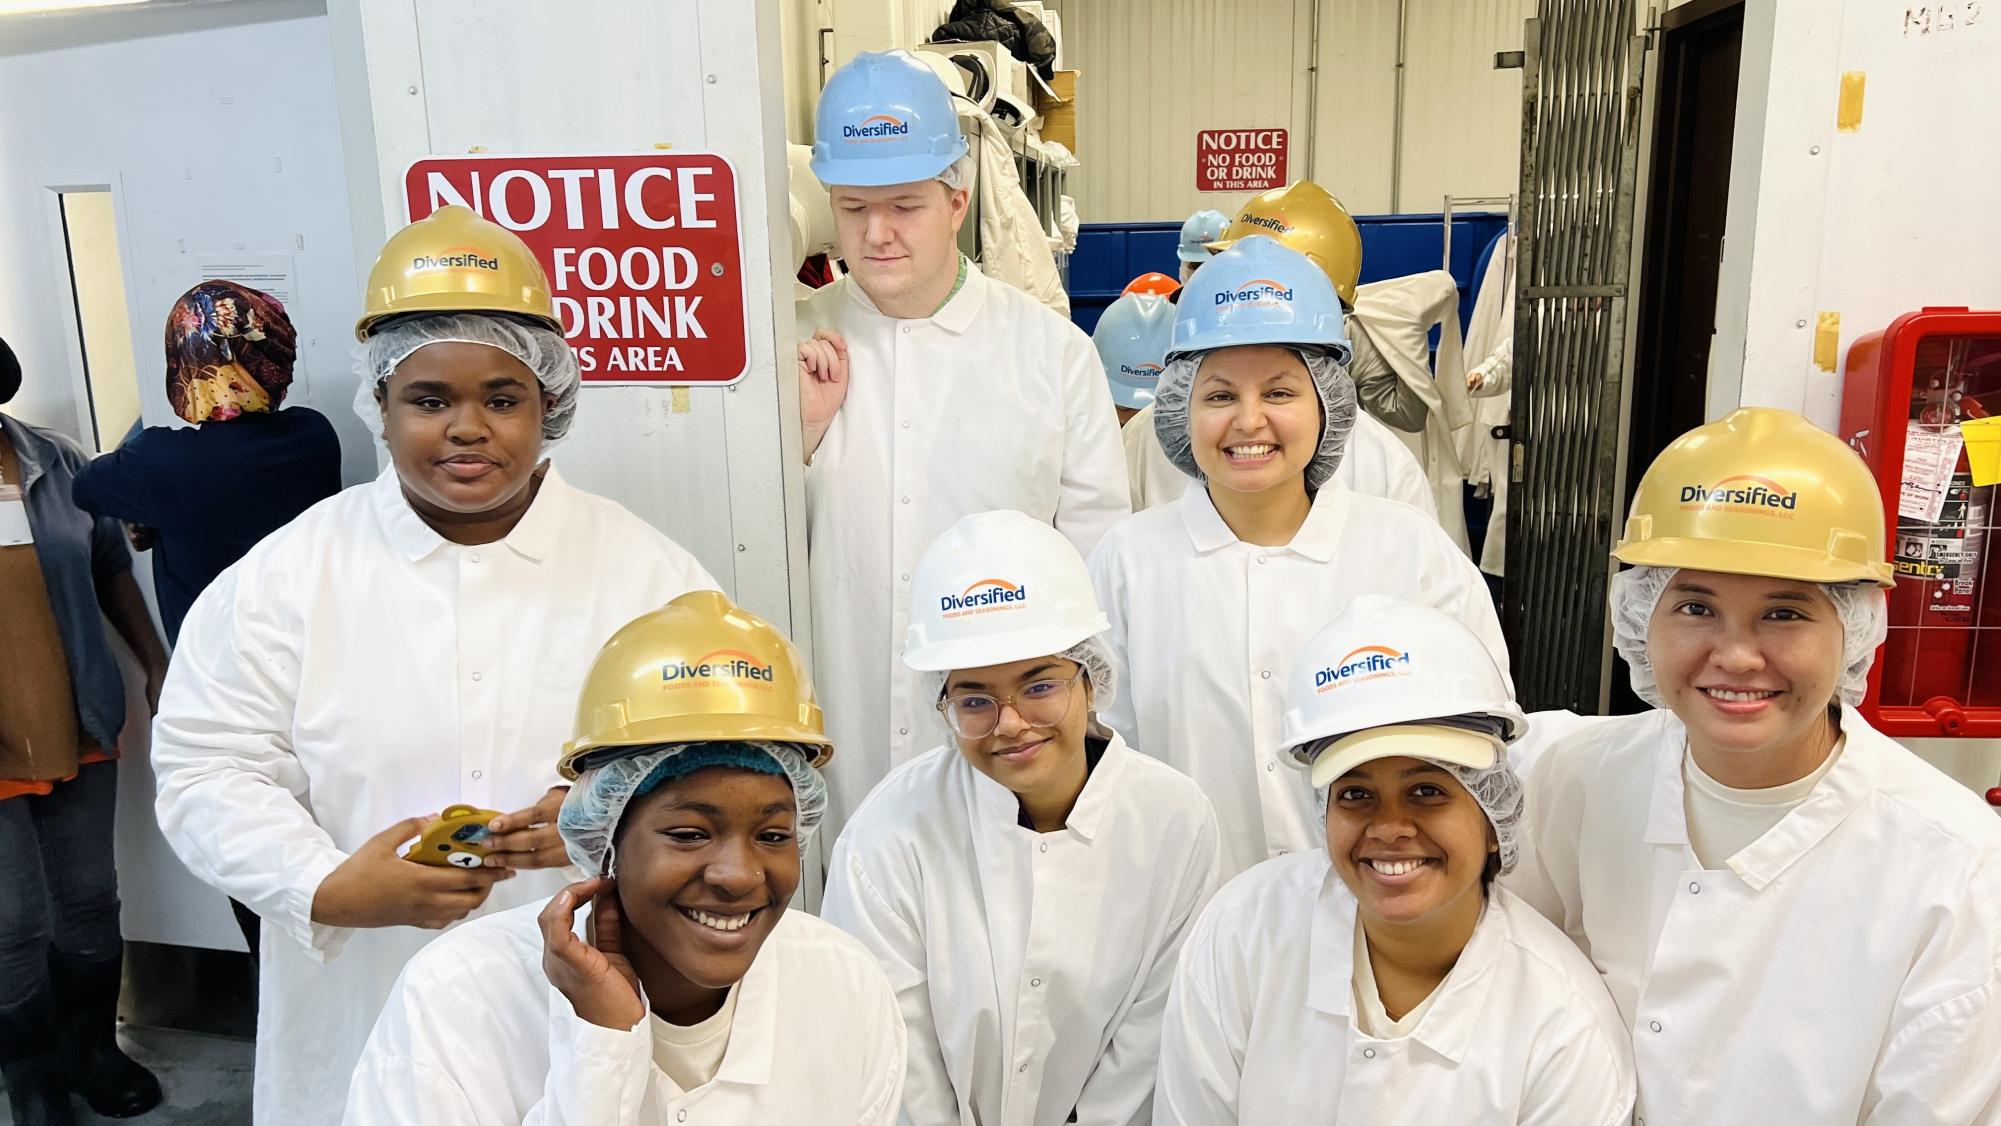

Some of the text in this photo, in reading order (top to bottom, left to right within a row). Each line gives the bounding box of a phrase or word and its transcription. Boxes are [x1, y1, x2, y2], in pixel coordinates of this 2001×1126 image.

[843, 122, 908, 137] Diversified
[1202, 131, 1283, 150] NOTICE
[1207, 152, 1276, 166] NO FOOD
[1206, 166, 1277, 180] OR DRINK
[1213, 180, 1269, 189] IN THIS AREA
[427, 166, 717, 231] NOTICE
[413, 254, 498, 270] Diversified
[553, 246, 699, 291] FOOD
[1215, 286, 1293, 305] Diversified
[552, 296, 708, 339] DRINK
[606, 346, 685, 371] AREA
[1121, 365, 1163, 377] Diversifie
[1680, 485, 1797, 510] Diversified
[941, 585, 1026, 611] Diversified
[662, 660, 773, 681] Diversified
